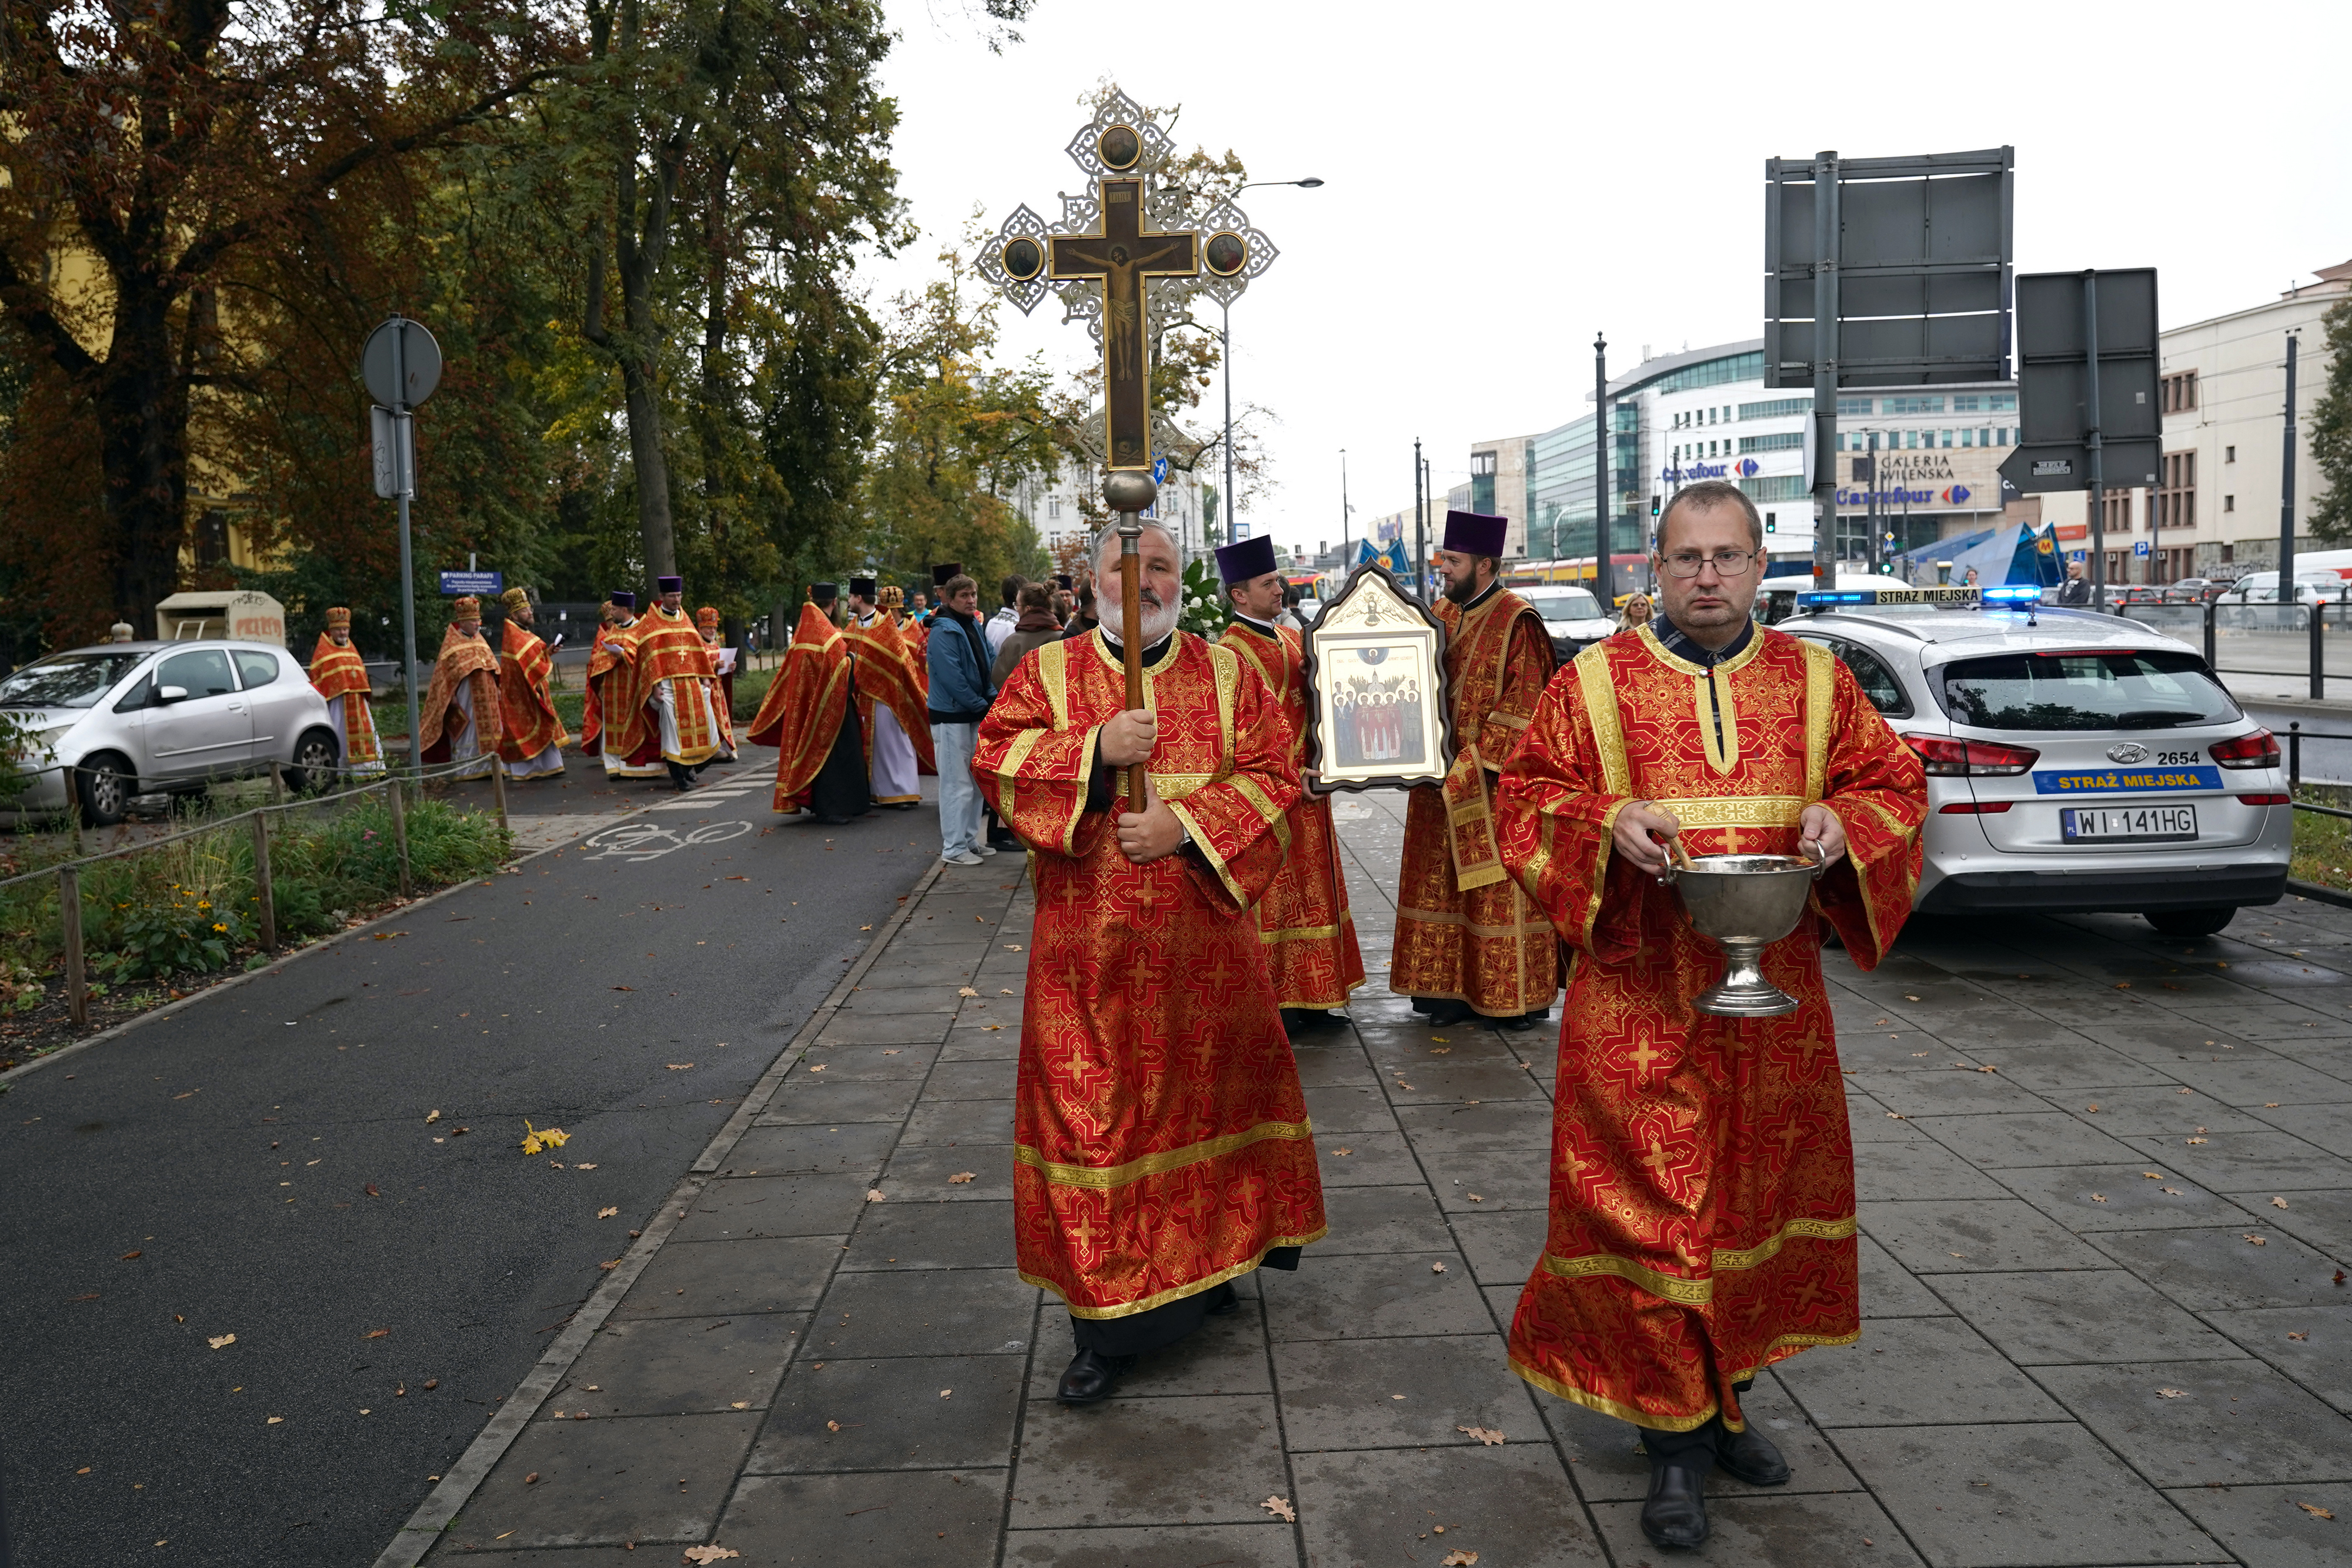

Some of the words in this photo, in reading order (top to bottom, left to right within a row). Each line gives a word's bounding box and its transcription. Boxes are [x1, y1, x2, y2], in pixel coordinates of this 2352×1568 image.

[1882, 456, 1949, 468] GALERIA
[1663, 462, 1726, 482] Caefour
[1882, 467, 1953, 480] WILEŃSKA
[1836, 487, 1933, 505] Carrefour
[2137, 543, 2147, 555] P
[1924, 589, 1978, 602] MIEJSKA
[2157, 751, 2200, 765] 2654
[2059, 773, 2119, 789] STRAŻ
[2124, 774, 2201, 787] MIEJSKA
[2079, 811, 2107, 834] WI
[2122, 810, 2191, 833] 141HG
